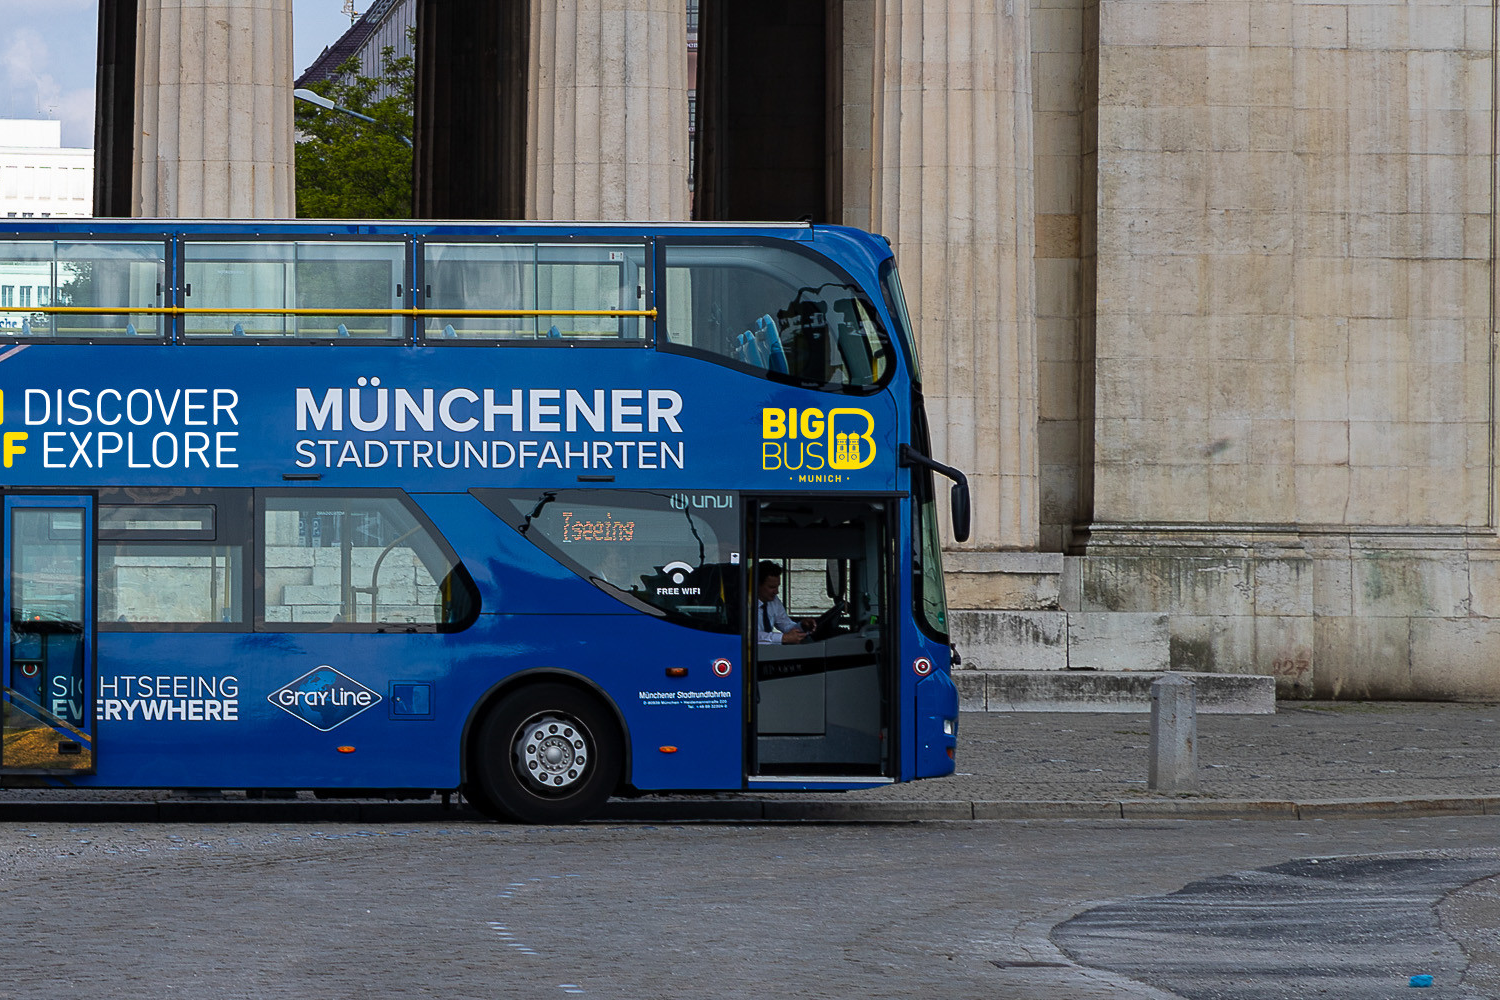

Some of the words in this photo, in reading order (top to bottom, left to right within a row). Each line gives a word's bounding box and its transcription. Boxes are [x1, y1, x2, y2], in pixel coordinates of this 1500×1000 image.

[24, 388, 239, 426] DISCOVER
[296, 376, 683, 433] MÜNCHENER
[762, 407, 825, 439] BIG
[43, 431, 239, 468] EXPLORE
[295, 439, 684, 469] STADTRUNDFAHRTEN
[762, 442, 825, 470] BUS
[798, 475, 842, 483] MUNICH
[656, 587, 680, 595] FREE
[681, 587, 701, 595] WIFI
[52, 675, 239, 698] SIHTSEEING
[639, 691, 675, 699] Münchener
[676, 690, 731, 699] Stadtrundfahrten
